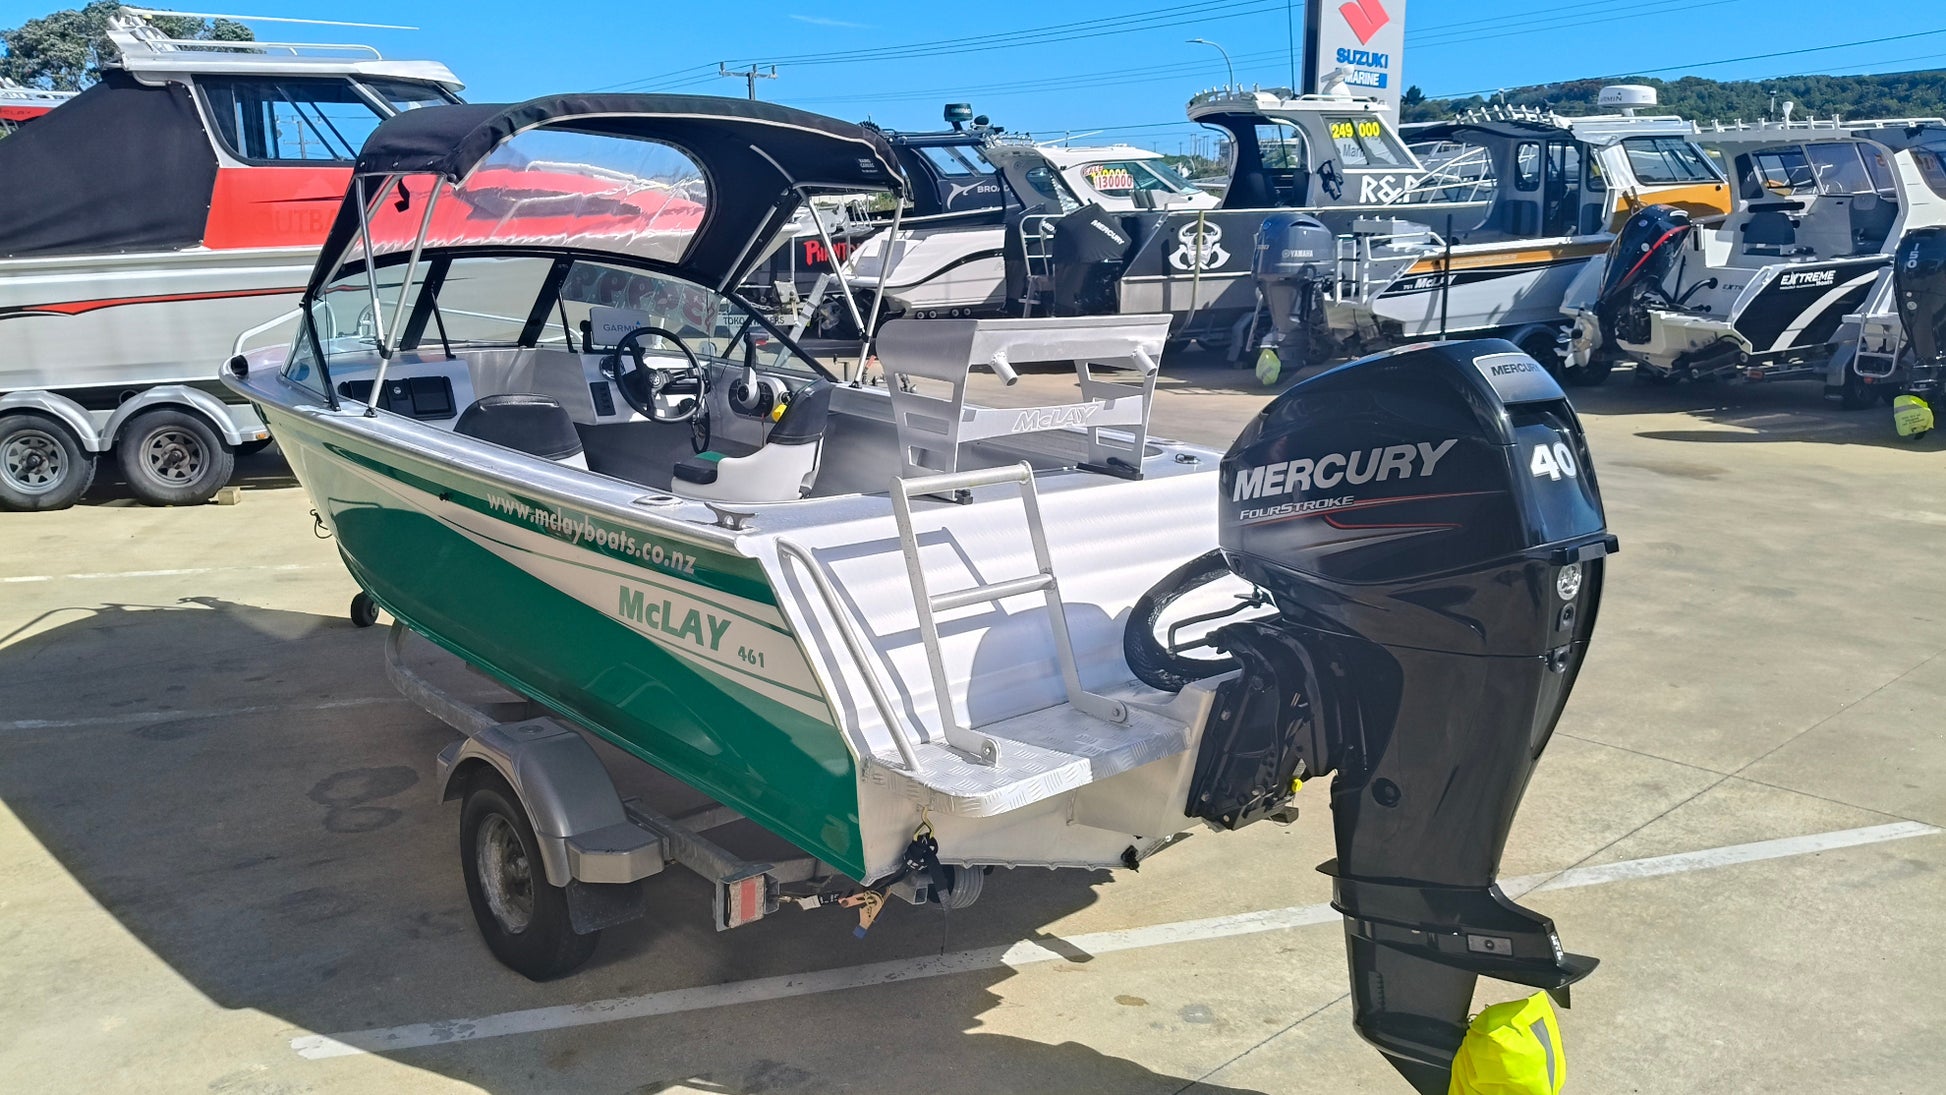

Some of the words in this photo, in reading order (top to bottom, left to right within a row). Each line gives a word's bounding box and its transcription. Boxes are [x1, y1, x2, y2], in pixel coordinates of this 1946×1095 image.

[1336, 48, 1389, 69] SUZUKI
[1344, 70, 1380, 86] MARINE
[1331, 123, 1354, 139] 249
[1358, 121, 1380, 137] 000
[1091, 219, 1125, 245] MERCURY
[1781, 270, 1836, 285] EXTREME
[1012, 405, 1098, 433] McLAY
[1232, 439, 1458, 502] MERCURY
[1531, 441, 1577, 481] 40
[487, 493, 696, 574] www.mclayboats.co.nz
[618, 585, 731, 650] McLAY
[738, 646, 765, 668] 461
